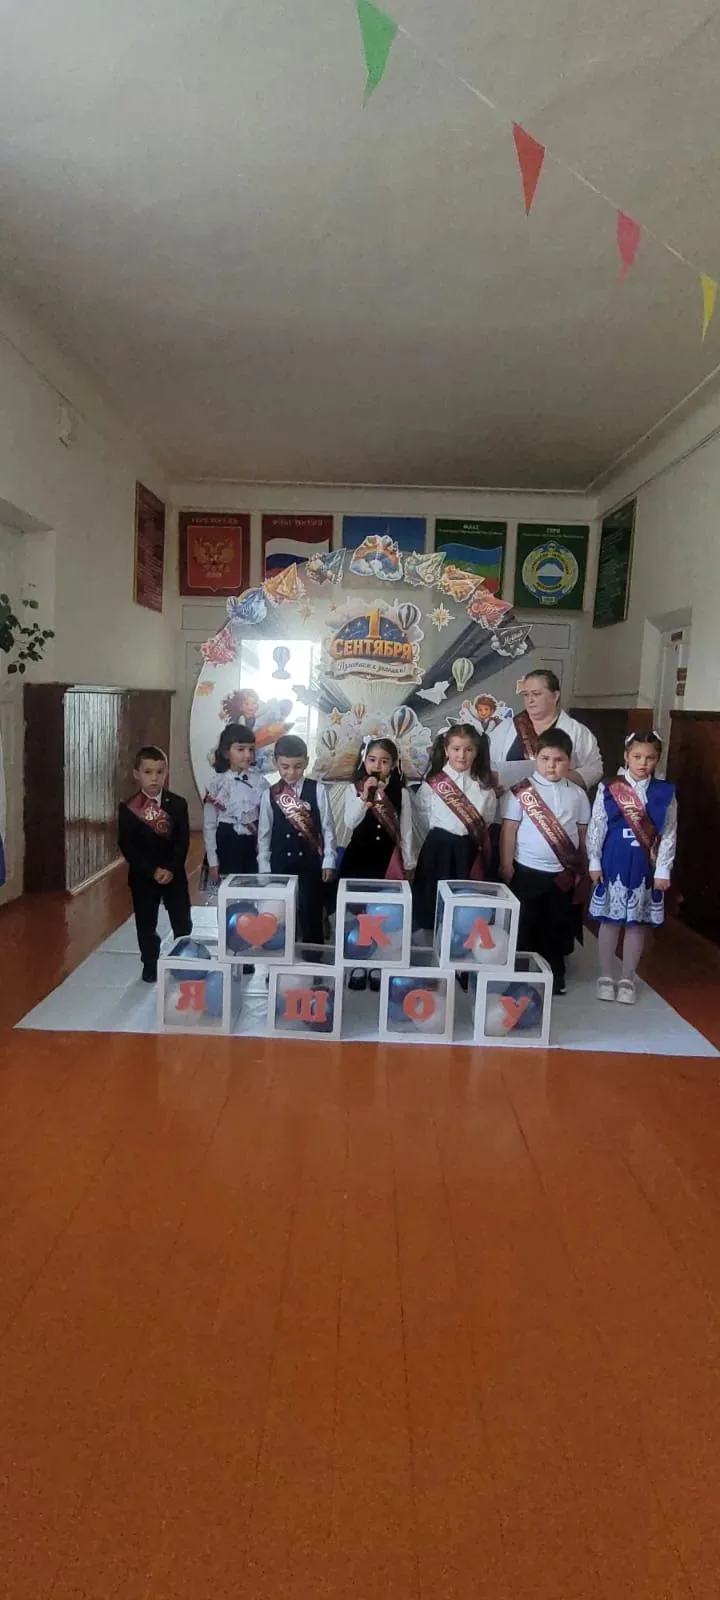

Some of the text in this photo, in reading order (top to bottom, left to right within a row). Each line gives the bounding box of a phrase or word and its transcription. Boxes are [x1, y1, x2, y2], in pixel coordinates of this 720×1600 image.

[366, 608, 381, 639] 1
[333, 638, 413, 661] СЕНТЯБРЯ
[356, 913, 497, 950] К Л
[175, 979, 532, 1031] Я Ш О У
